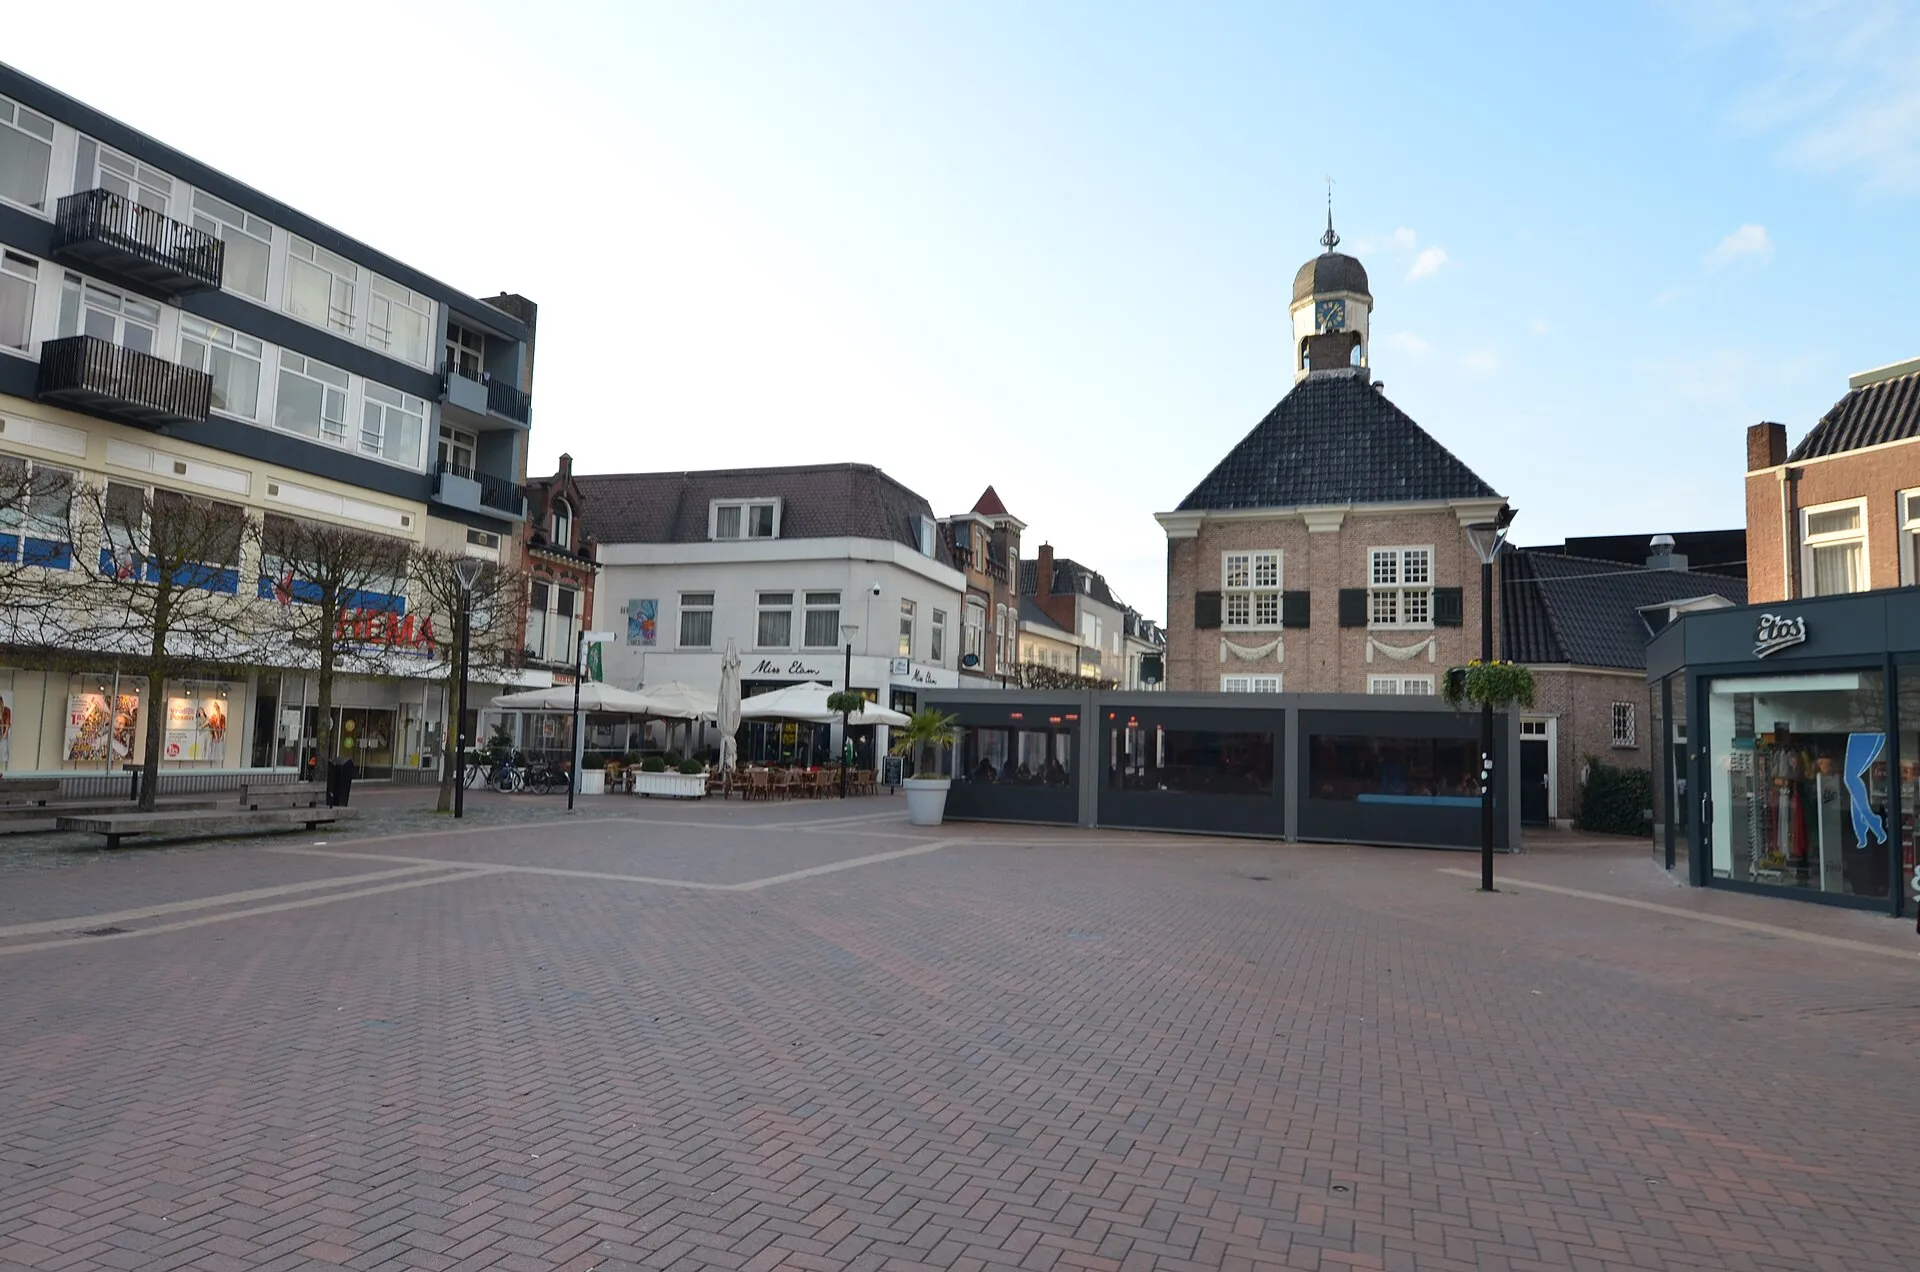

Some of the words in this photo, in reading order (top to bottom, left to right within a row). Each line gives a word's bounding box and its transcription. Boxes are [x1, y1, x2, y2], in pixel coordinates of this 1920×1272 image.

[336, 607, 437, 651] HEMA
[1755, 613, 1806, 646] Etos
[752, 660, 780, 674] Miss
[788, 660, 820, 674] Etam
